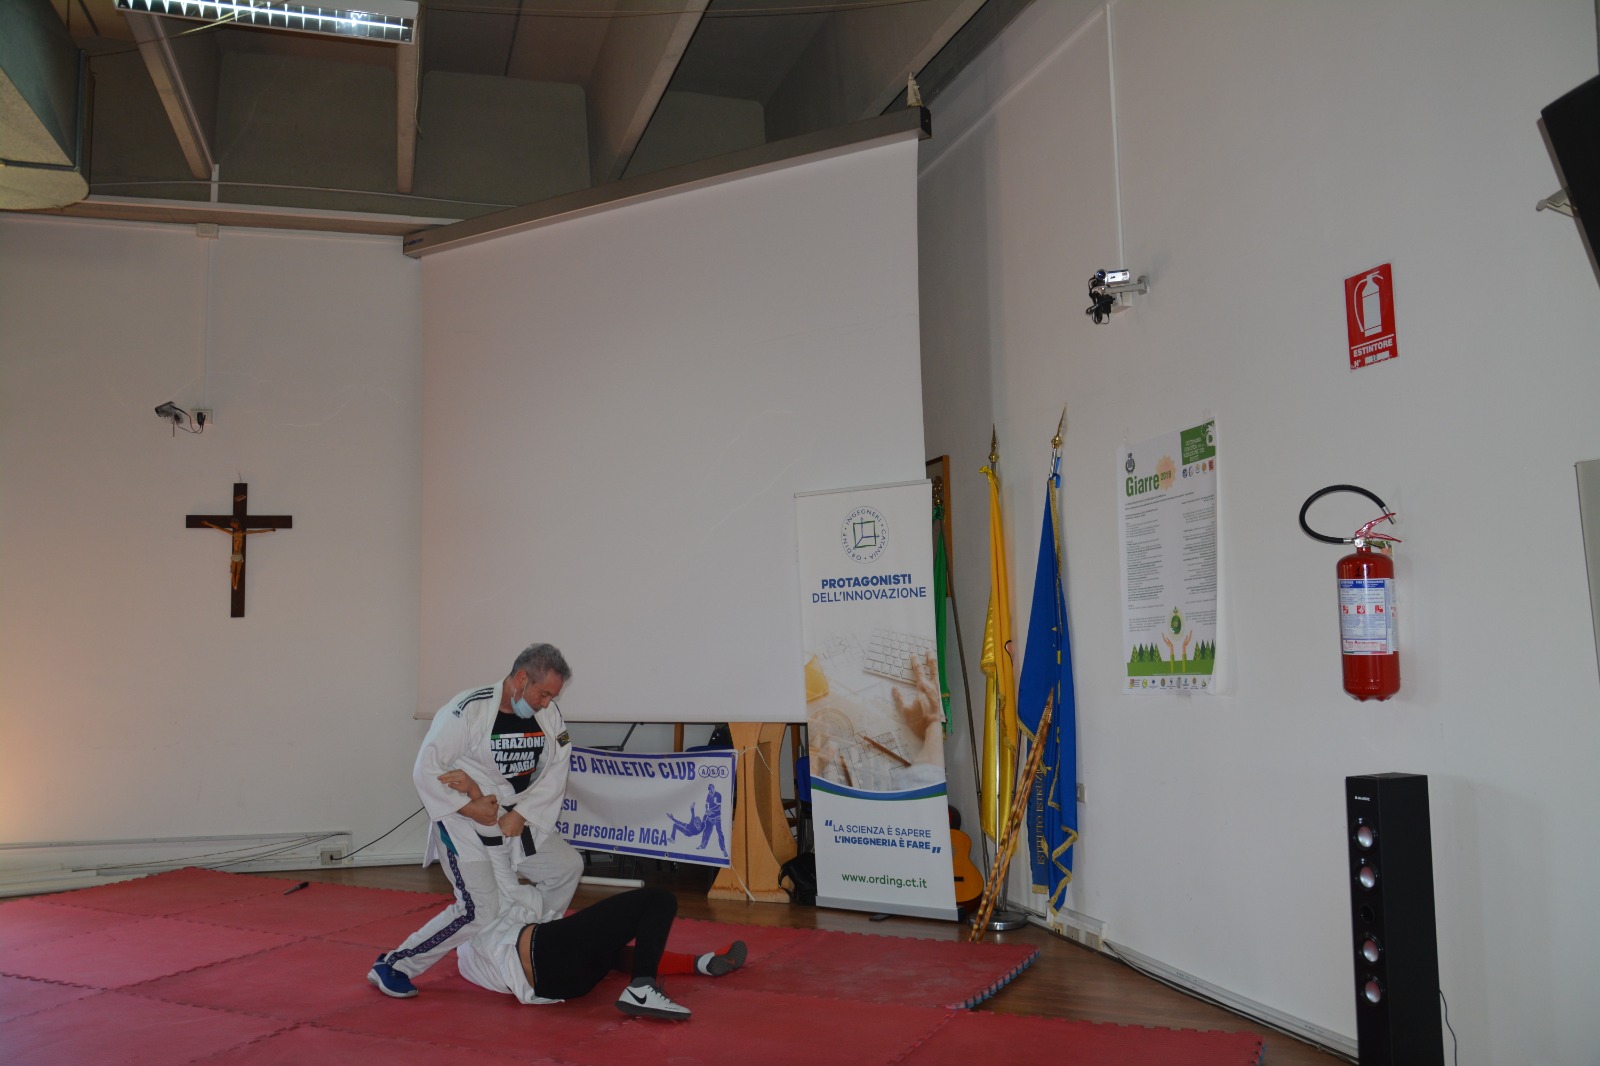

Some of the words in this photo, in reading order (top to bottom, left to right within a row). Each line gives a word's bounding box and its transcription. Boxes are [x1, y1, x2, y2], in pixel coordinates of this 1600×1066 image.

[1353, 339, 1393, 357] ESTINTORE
[1125, 474, 1160, 497] Giarre
[845, 508, 882, 526] INGEGNERI
[869, 529, 887, 560] CATANIA
[821, 574, 912, 590] PROTAGONISTI
[591, 757, 656, 779] ATHLETIC
[658, 761, 696, 781] CLUB
[561, 798, 578, 811] su
[573, 823, 635, 843] personale
[639, 827, 668, 847] MGA
[846, 824, 885, 835] SCIENZA
[887, 825, 893, 836] È
[895, 828, 931, 839] SAPERE
[899, 837, 905, 848] È
[906, 840, 931, 850] FARE
[841, 873, 928, 889] www.ording.ct.it
